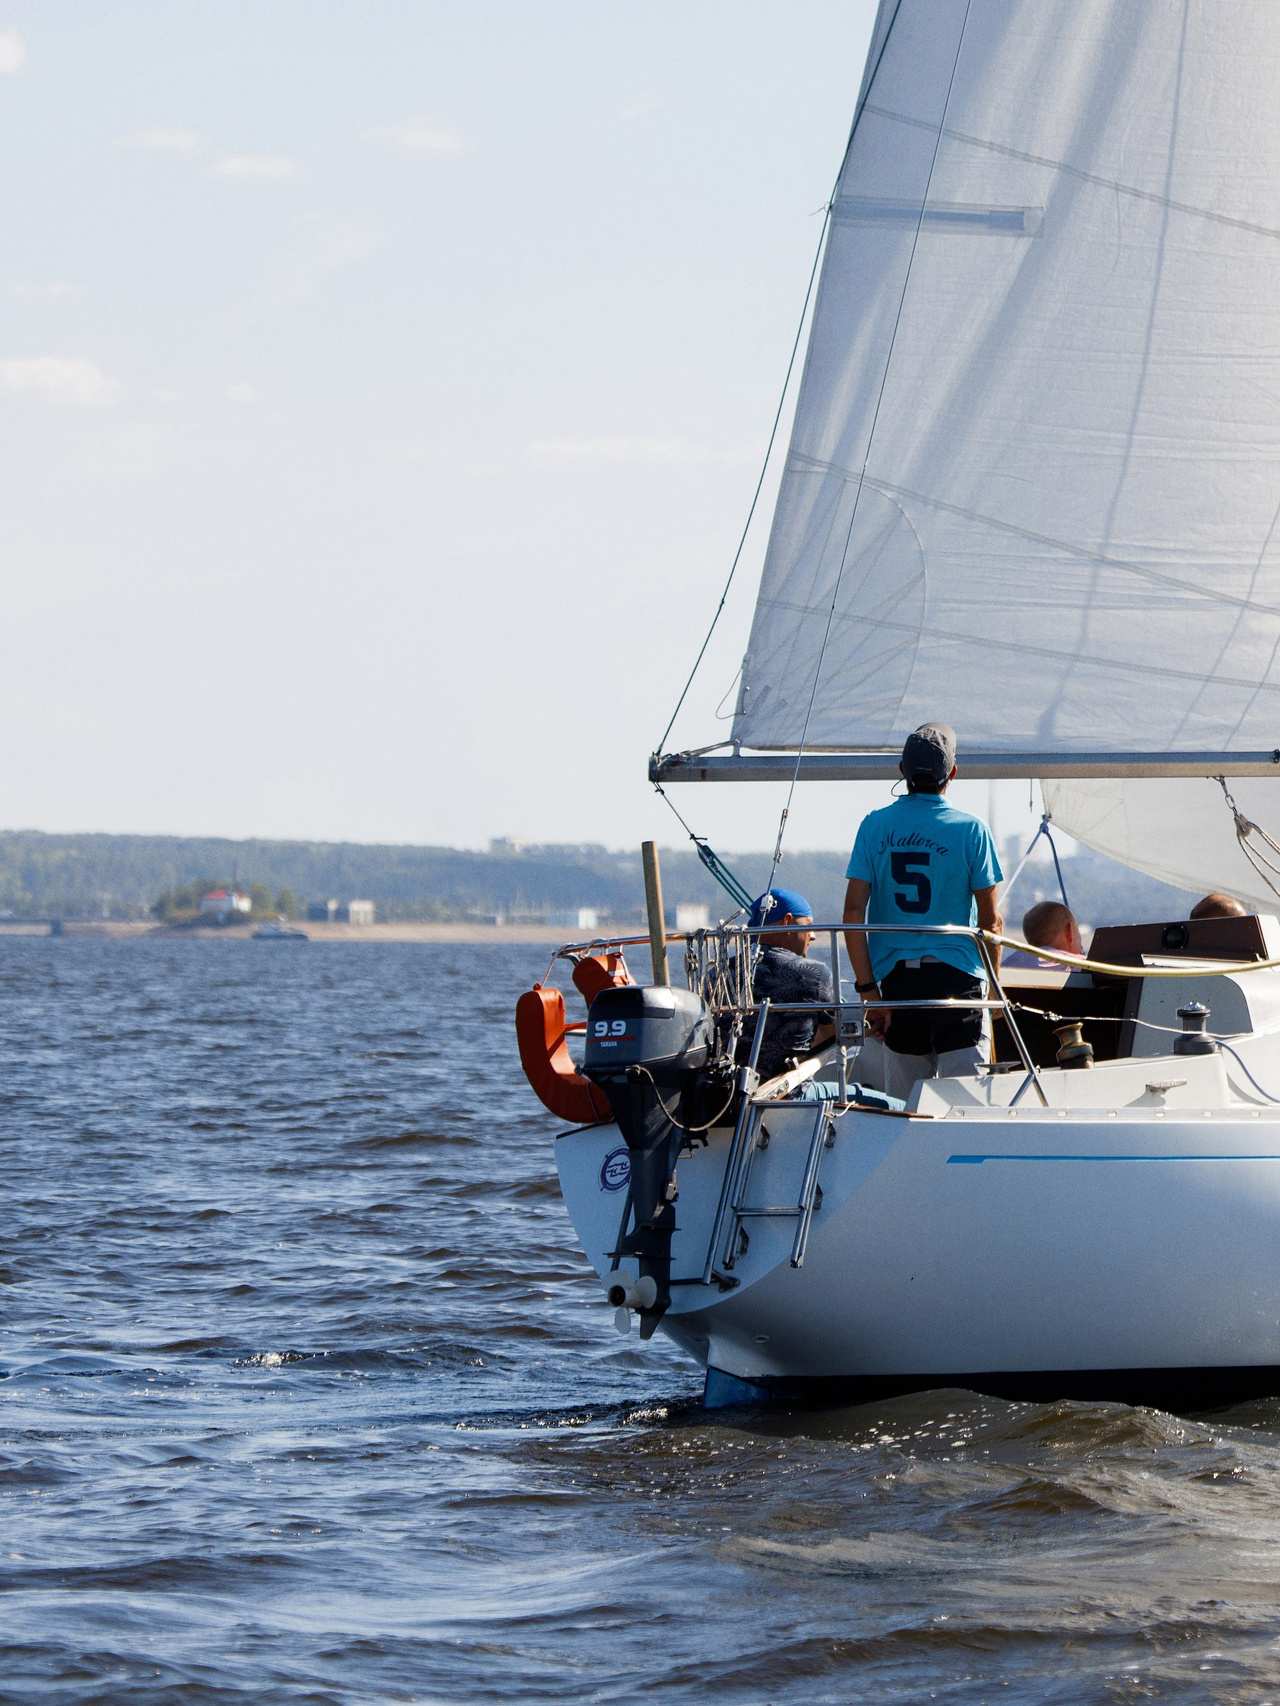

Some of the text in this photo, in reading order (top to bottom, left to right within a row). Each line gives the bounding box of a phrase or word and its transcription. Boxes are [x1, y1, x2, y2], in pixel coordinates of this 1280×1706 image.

[878, 829, 949, 856] Mallorca
[891, 852, 931, 914] 5
[594, 1020, 627, 1037] 9.9
